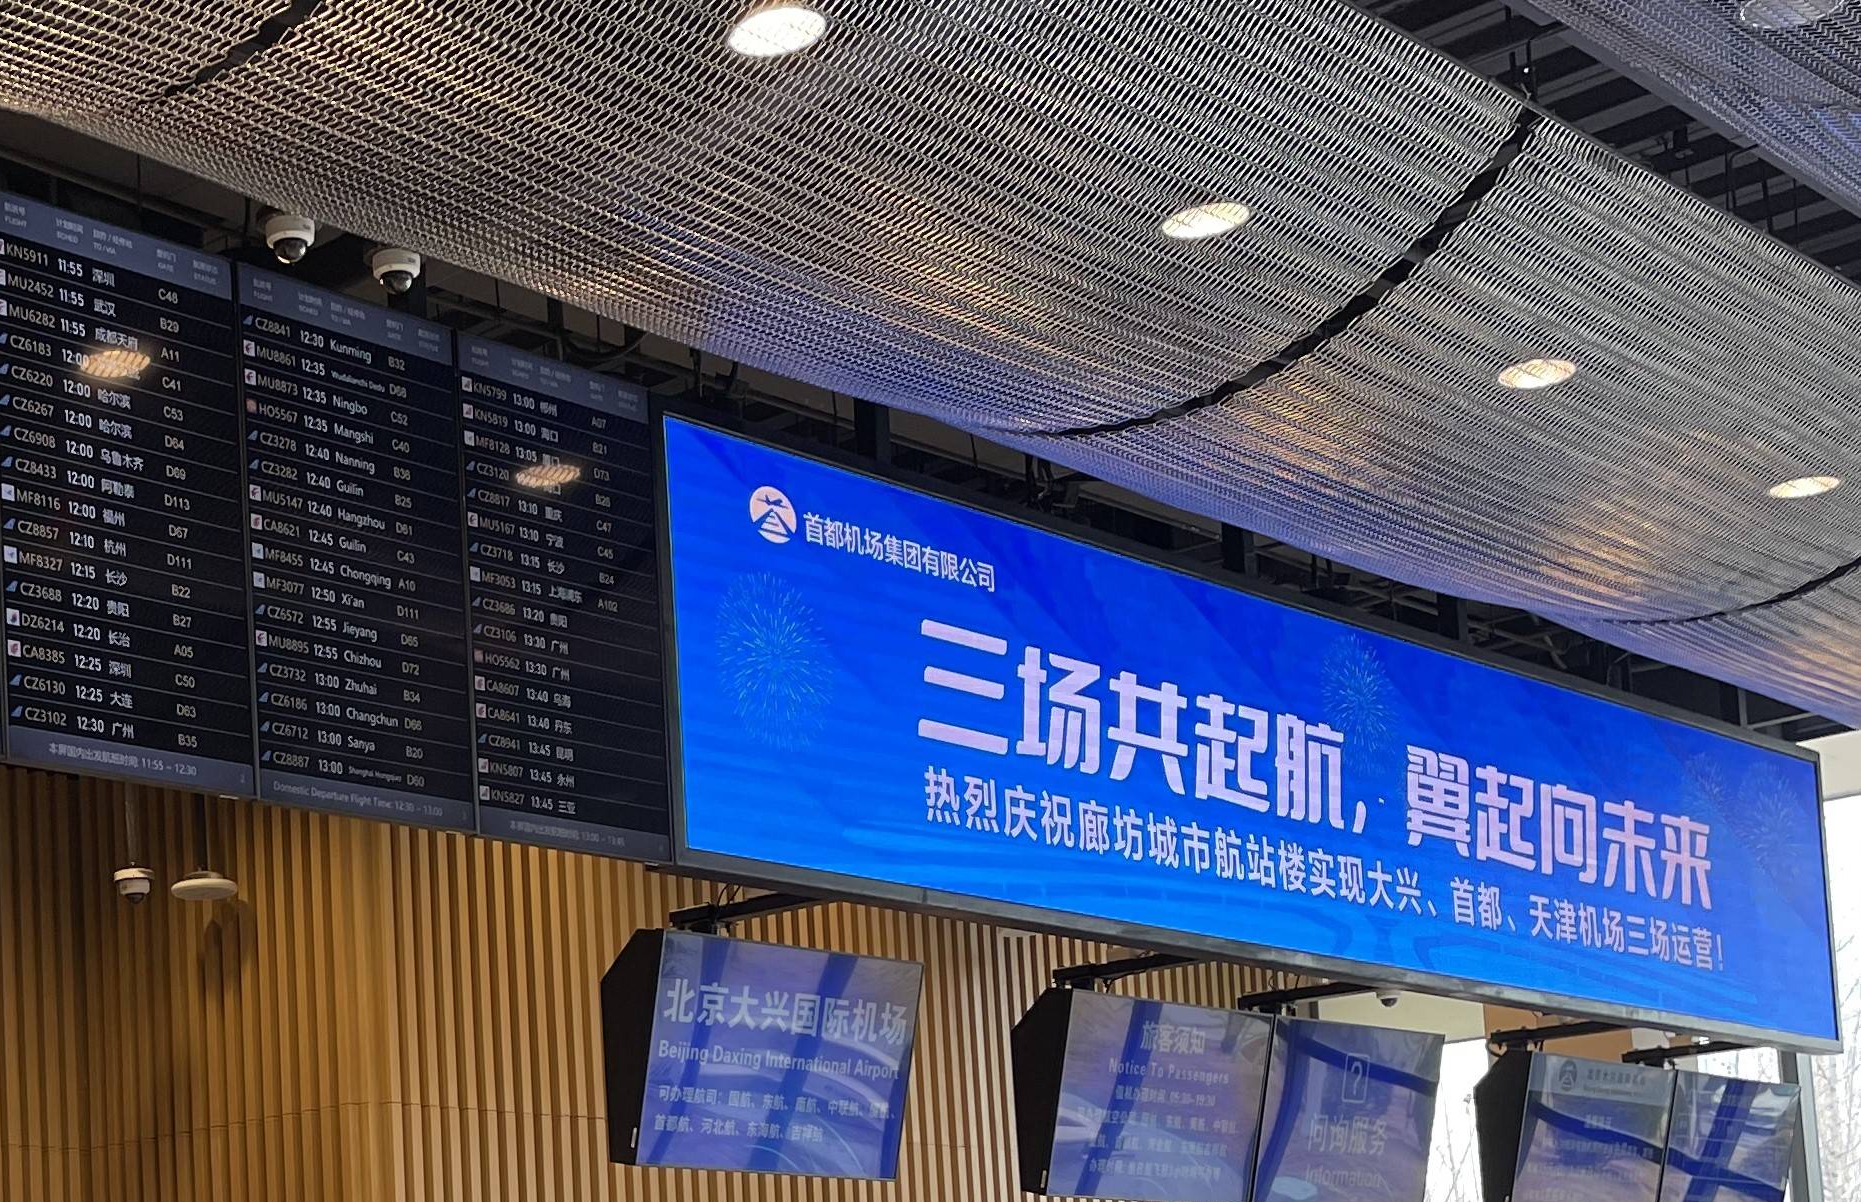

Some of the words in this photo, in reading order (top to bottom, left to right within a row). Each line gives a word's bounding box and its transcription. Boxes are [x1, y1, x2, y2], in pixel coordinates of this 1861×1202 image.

[6, 243, 49, 267] KN5911
[58, 258, 82, 276] 11:55
[255, 317, 290, 337] CZ8841
[301, 330, 323, 347] 12:30
[330, 339, 372, 363] Kunming
[803, 513, 996, 593] 首都机场集团有限公司
[524, 634, 545, 648] 13:30
[25, 707, 66, 726] CZ3102
[77, 716, 104, 732] 12:30
[178, 734, 197, 747] B35
[272, 722, 308, 739] CZ6712
[318, 730, 341, 746] 13:00
[348, 736, 375, 753] Sanya
[663, 978, 907, 1045] 北京大兴国际机场
[1141, 1021, 1206, 1054] 旅客须知
[659, 1040, 708, 1064] Beijing
[713, 1045, 761, 1070] Daxing
[766, 1052, 850, 1075] International
[854, 1060, 899, 1081] Airport
[1109, 1058, 1146, 1076] Notice
[1151, 1064, 1163, 1079] To
[1168, 1064, 1229, 1086] Passengers
[1307, 1113, 1388, 1156] 问询服务
[1304, 1167, 1384, 1189] Information
